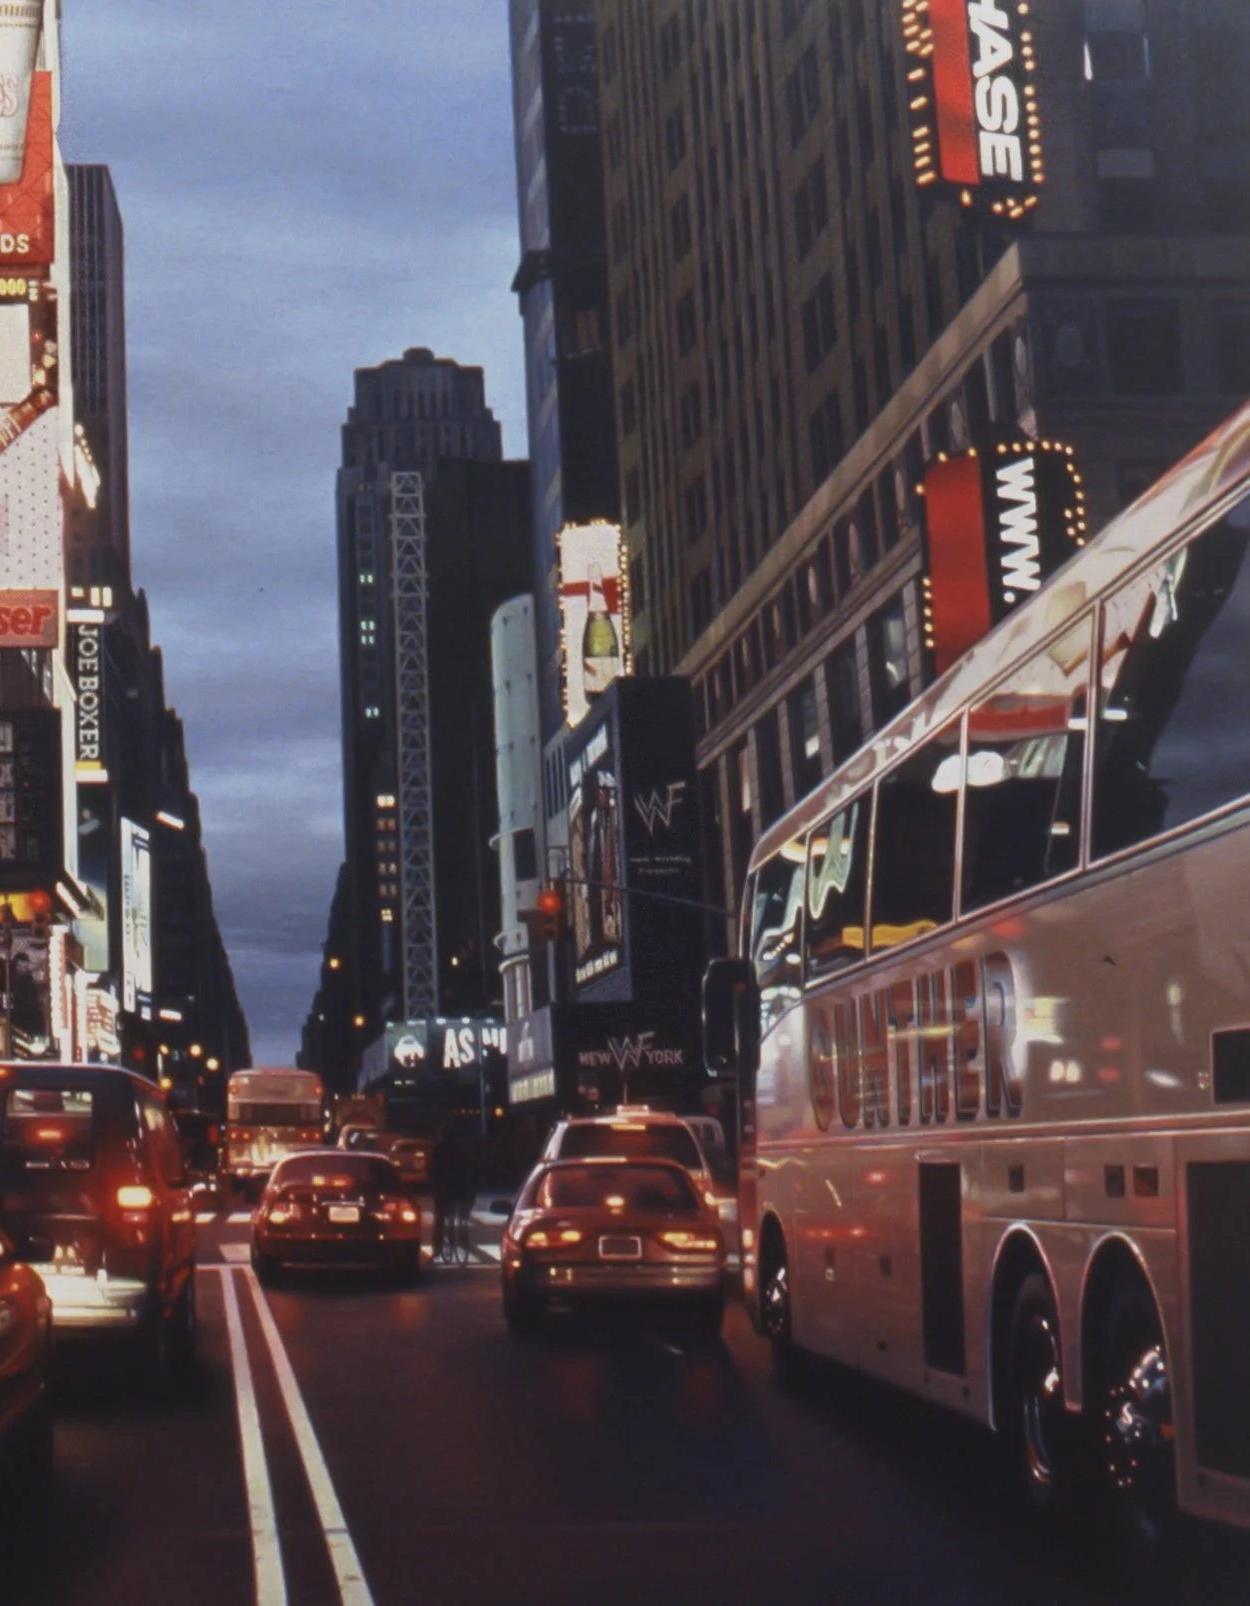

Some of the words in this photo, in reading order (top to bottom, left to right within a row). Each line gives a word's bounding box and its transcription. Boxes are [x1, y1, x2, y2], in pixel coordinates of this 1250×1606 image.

[78, 625, 99, 671] JOE
[79, 676, 100, 760] BOXER
[578, 1052, 611, 1067] NEW
[646, 1049, 684, 1065] YORK
